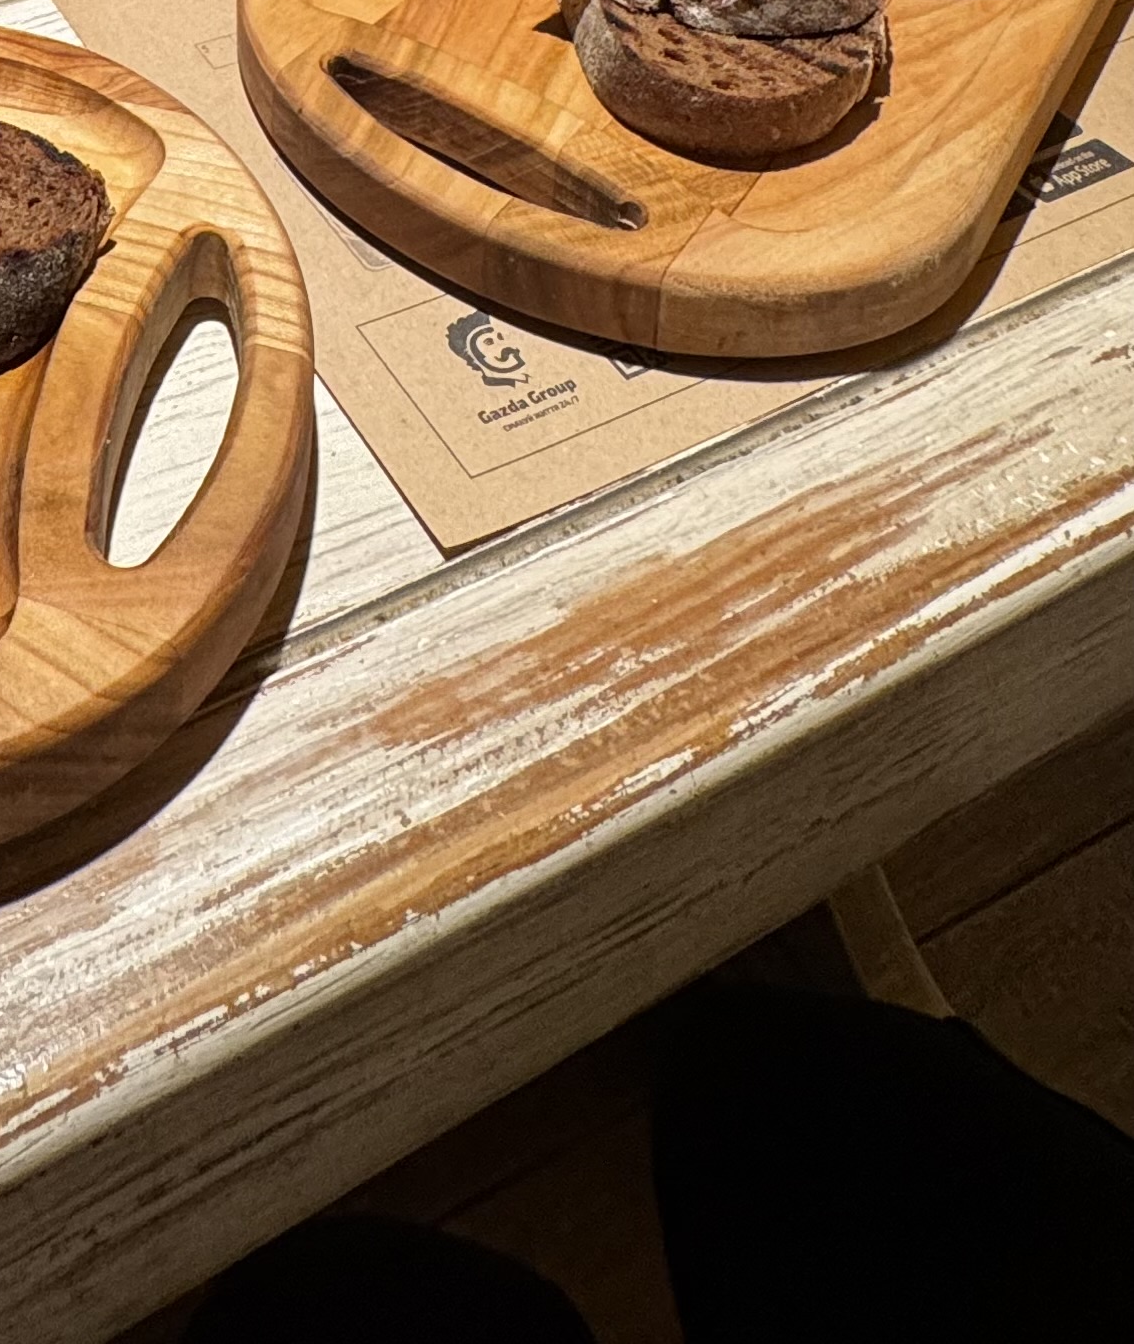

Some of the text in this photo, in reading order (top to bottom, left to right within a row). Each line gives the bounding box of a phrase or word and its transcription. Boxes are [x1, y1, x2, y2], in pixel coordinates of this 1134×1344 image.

[1051, 171, 1083, 187] App
[1074, 158, 1112, 177] Store
[477, 379, 577, 425] Gazda Group
